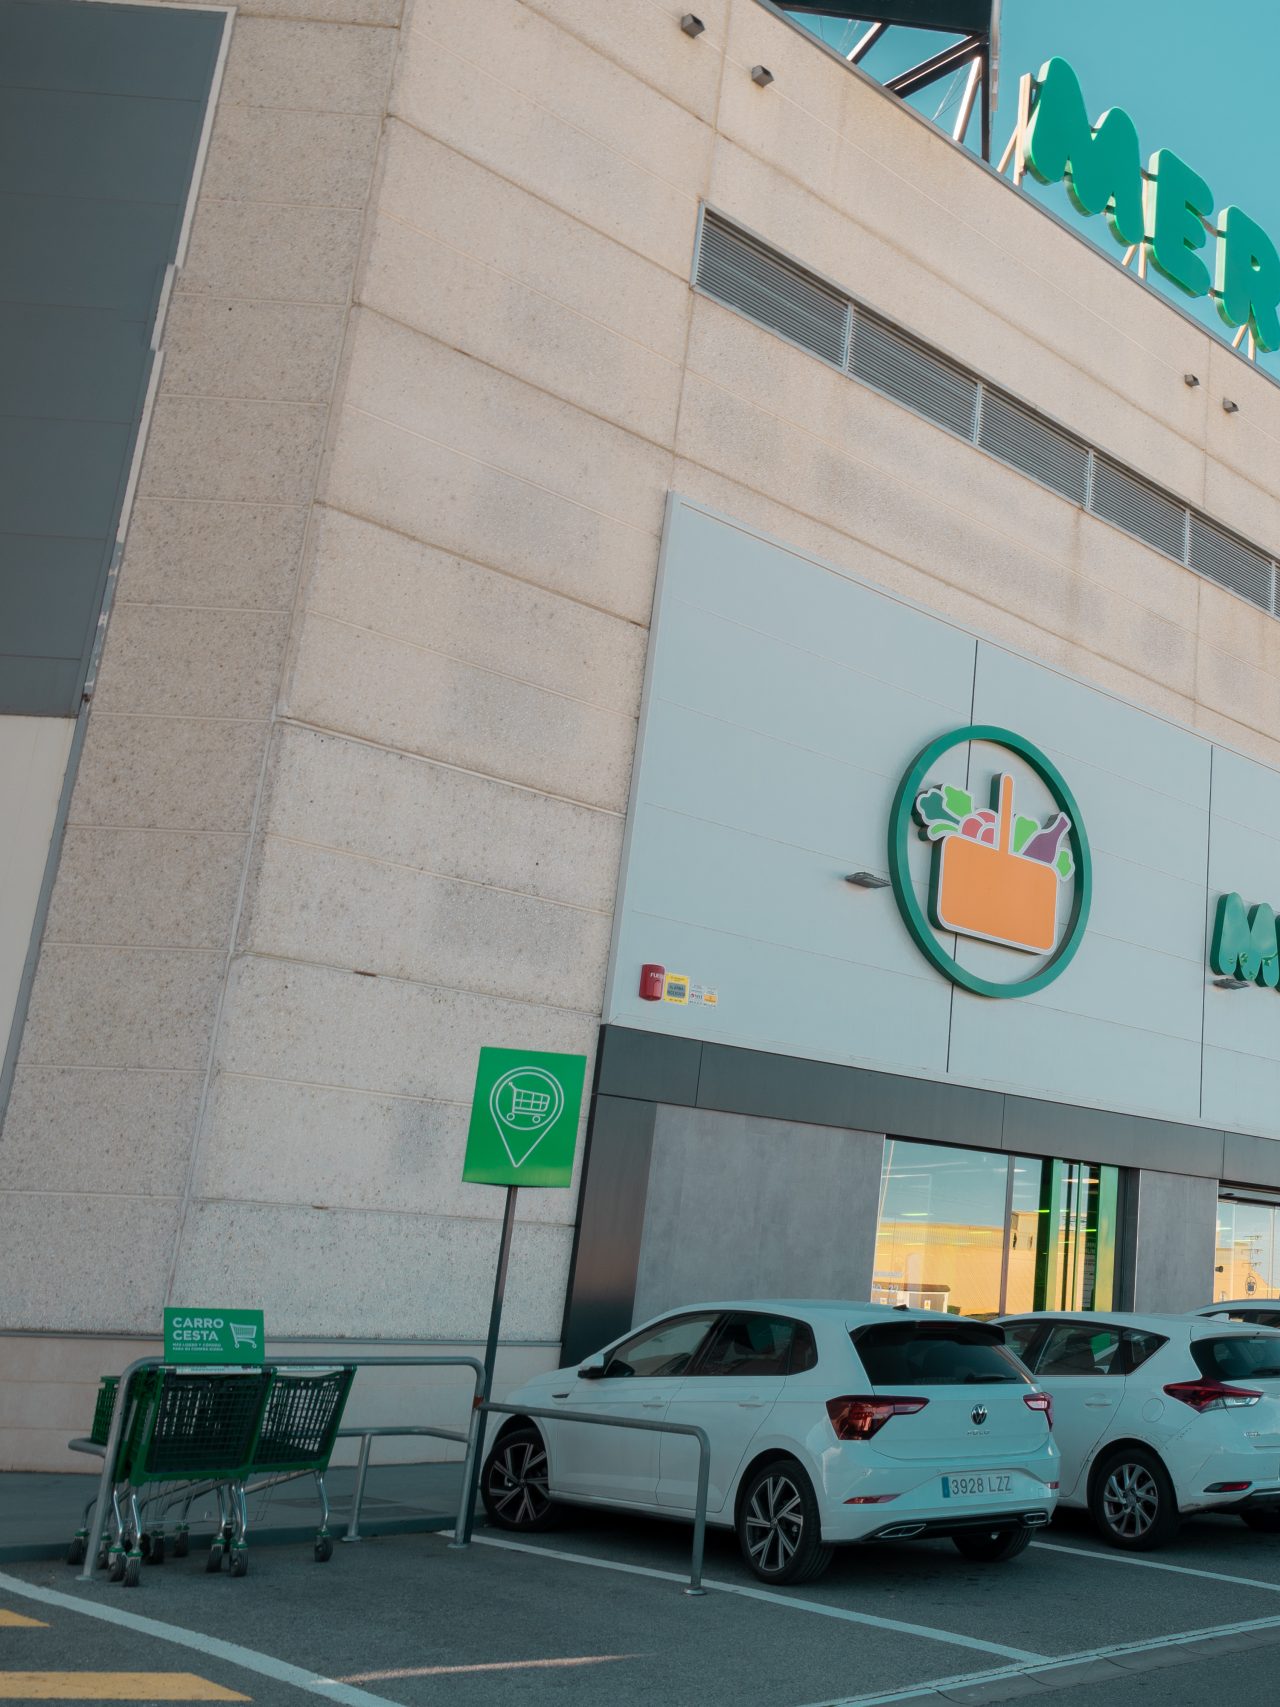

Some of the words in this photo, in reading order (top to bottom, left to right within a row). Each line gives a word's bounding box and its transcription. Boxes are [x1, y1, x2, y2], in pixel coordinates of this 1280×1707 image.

[172, 1317, 224, 1329] CARRO
[172, 1330, 219, 1341] CESTA
[951, 1478, 984, 1495] 3928
[988, 1476, 1011, 1492] LZZ
